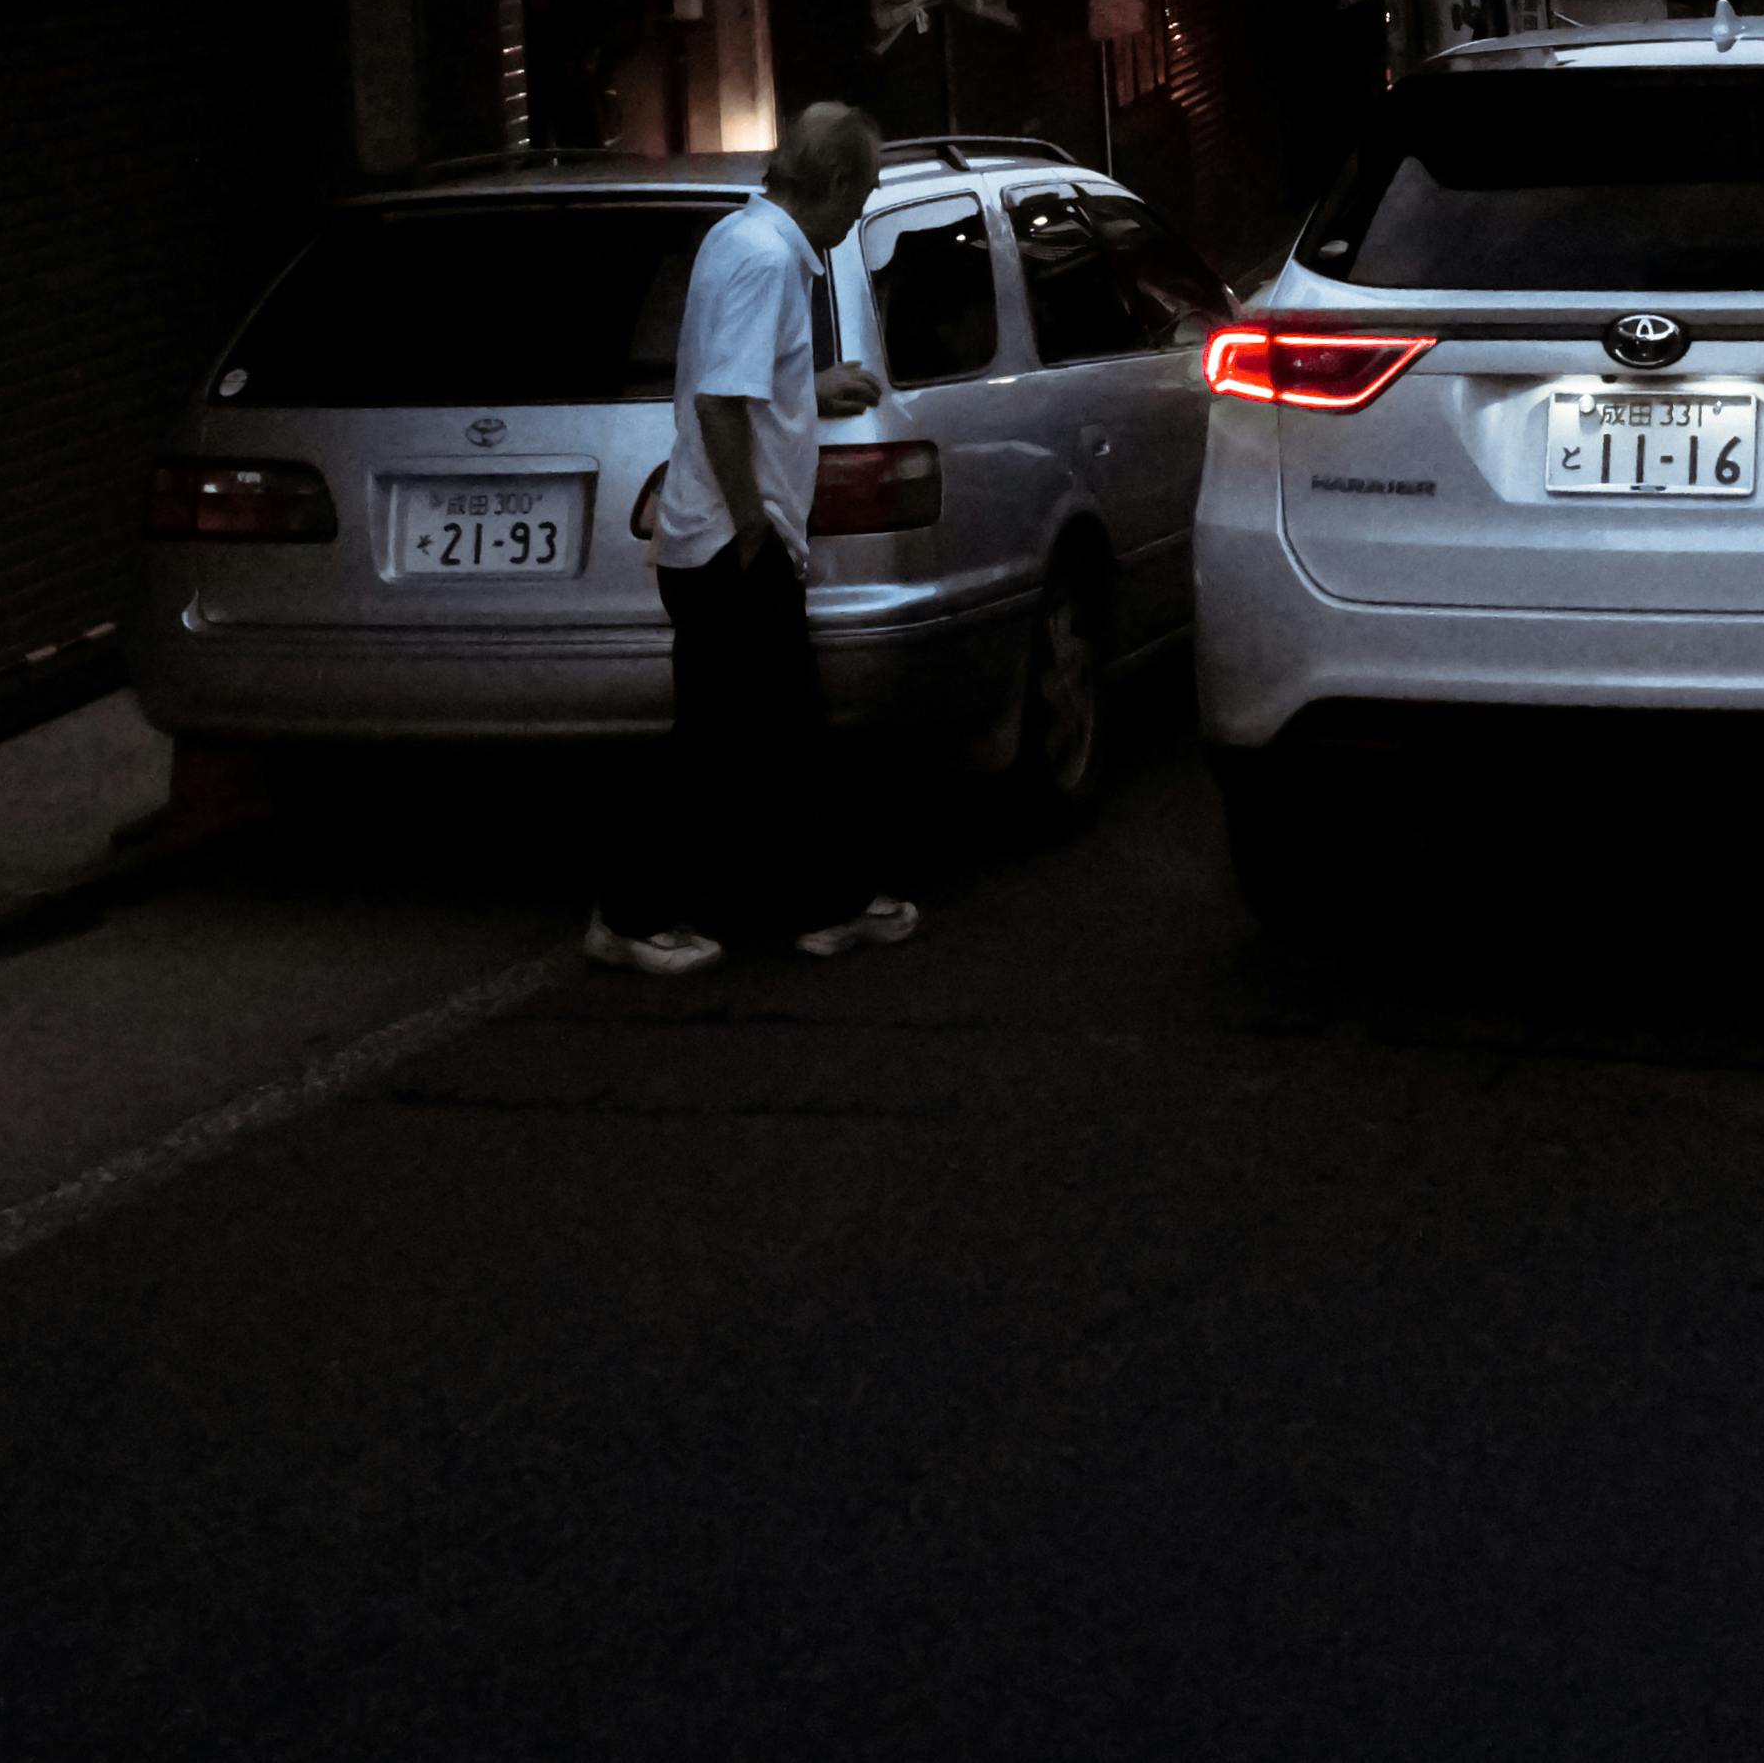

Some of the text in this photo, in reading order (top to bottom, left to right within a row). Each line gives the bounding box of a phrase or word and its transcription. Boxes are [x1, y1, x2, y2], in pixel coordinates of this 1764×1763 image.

[1599, 402, 1703, 428] 成田 331
[1562, 433, 1741, 485] と 11-16
[440, 521, 557, 566] 21-93
